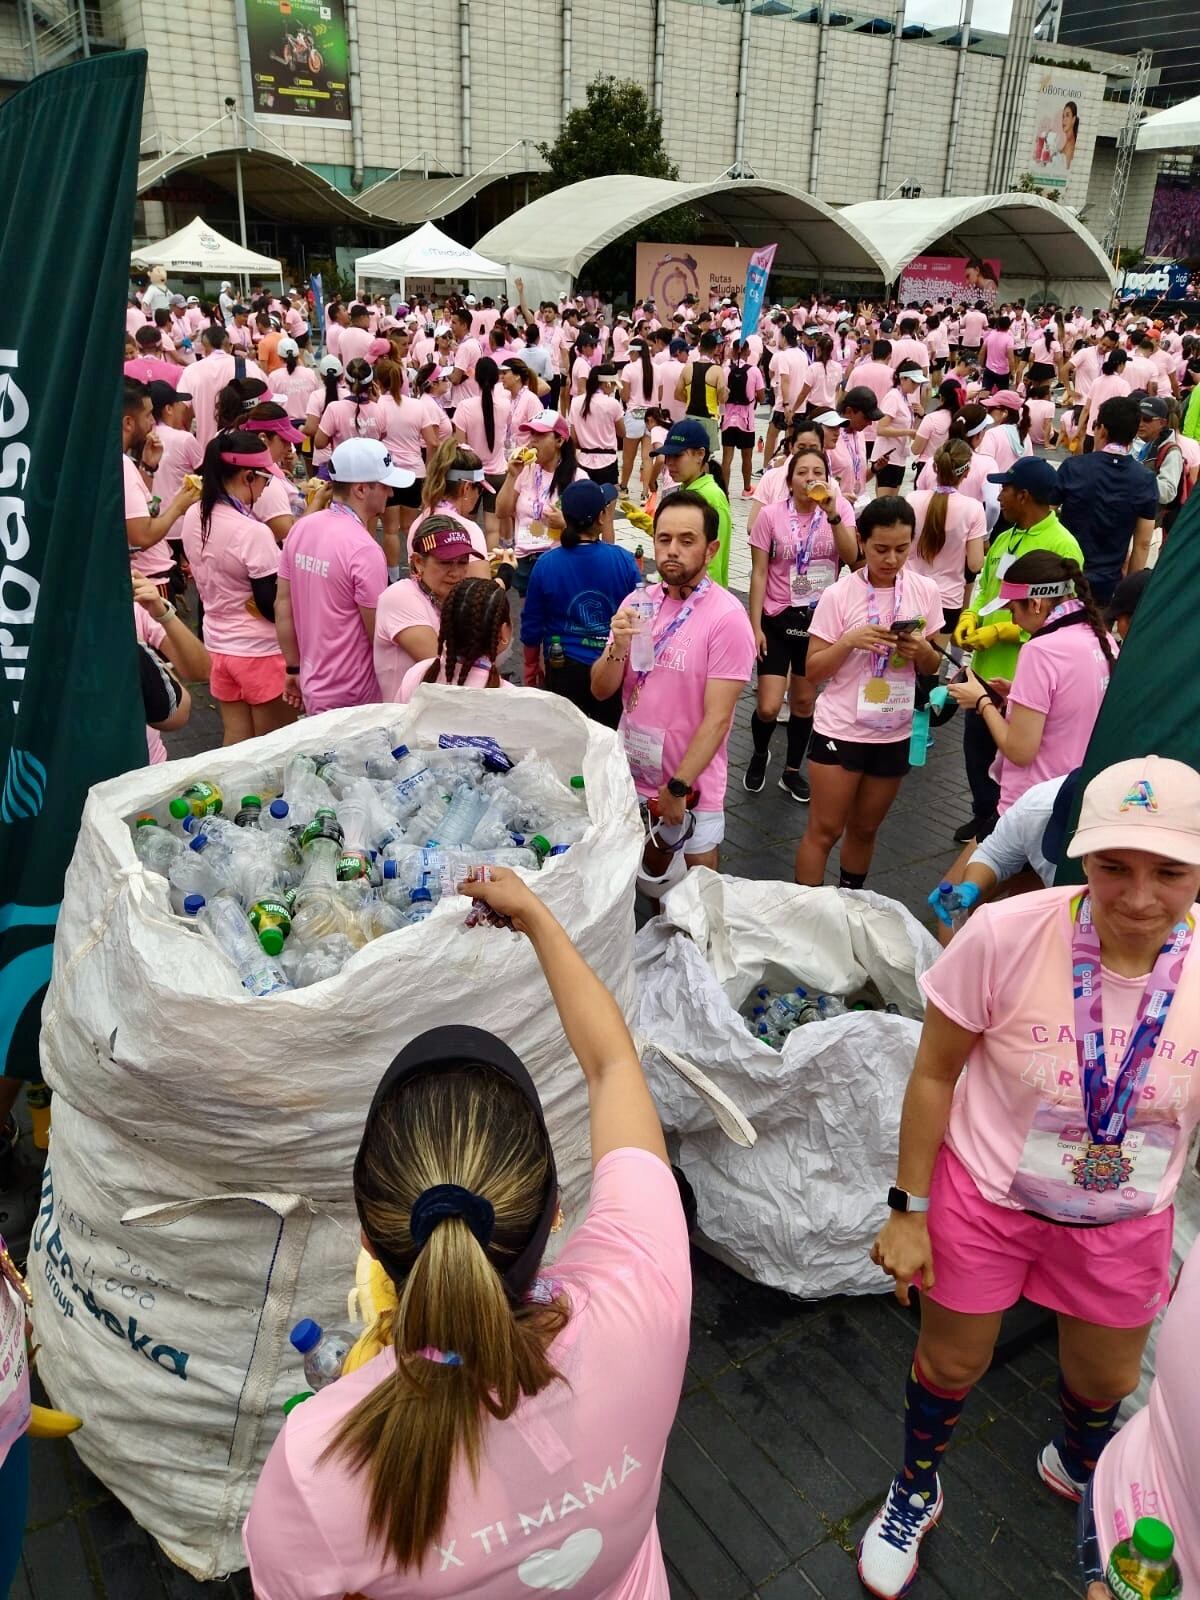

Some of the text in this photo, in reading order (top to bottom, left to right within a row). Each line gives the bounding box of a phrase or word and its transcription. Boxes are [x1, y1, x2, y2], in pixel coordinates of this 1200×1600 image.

[709, 273, 732, 284] Rutas
[1030, 585, 1060, 597] KOM
[1031, 1024, 1200, 1067] CARRA
[44, 1259, 75, 1318] Group
[432, 1445, 642, 1572] X TI MAMÁ
